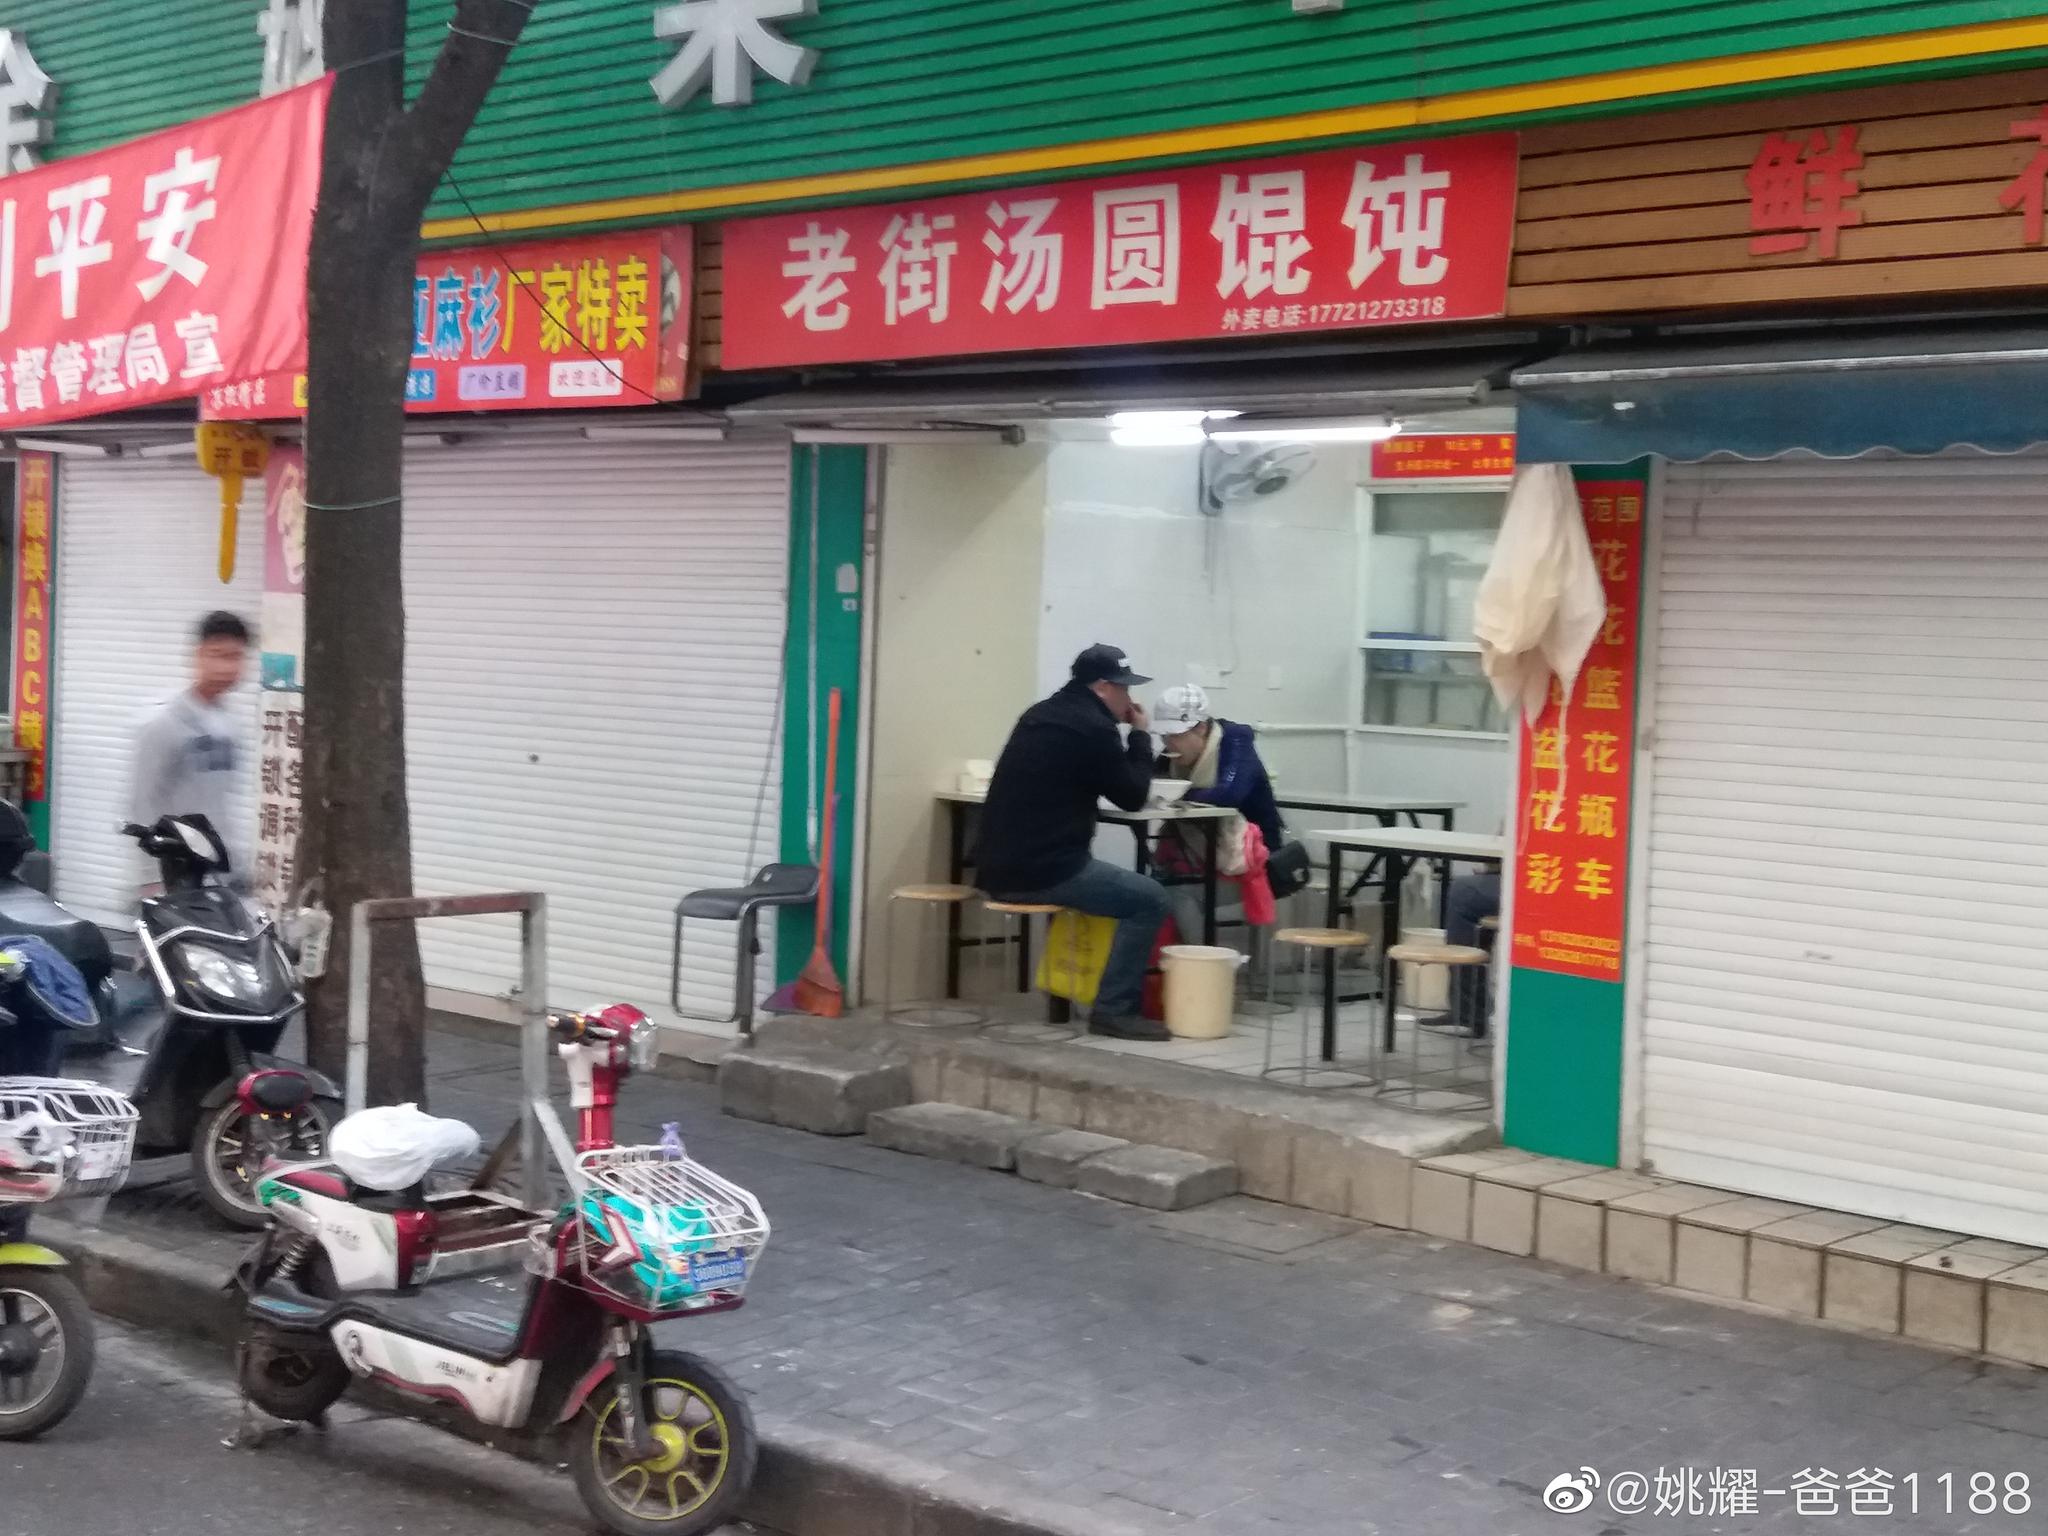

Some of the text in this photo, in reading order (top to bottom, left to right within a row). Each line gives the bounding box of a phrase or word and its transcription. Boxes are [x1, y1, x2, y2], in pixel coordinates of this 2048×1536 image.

[781, 154, 1450, 332] 老街汤圆馄饨
[0, 323, 171, 414] 督管理局
